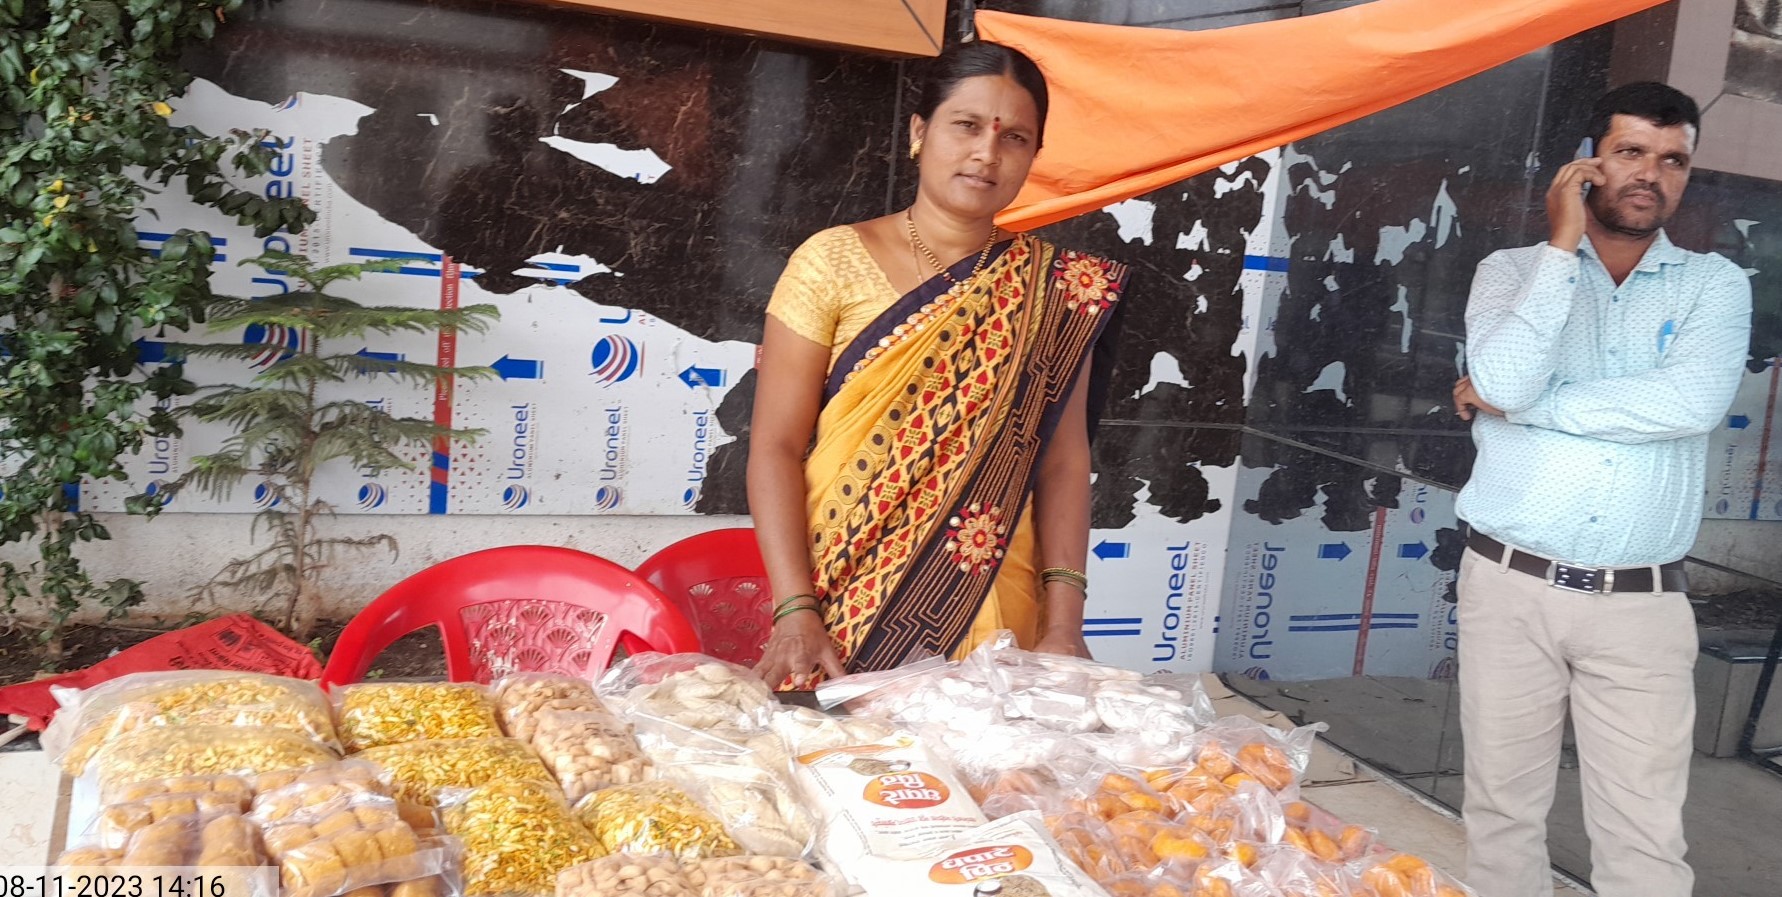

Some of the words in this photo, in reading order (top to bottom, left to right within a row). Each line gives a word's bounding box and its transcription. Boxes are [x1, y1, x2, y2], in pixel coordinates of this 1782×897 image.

[250, 136, 294, 301] Uroeel
[507, 403, 529, 480] Uroneel
[599, 406, 622, 481] Uroneel
[687, 409, 709, 482] Uroneel
[1187, 574, 1197, 603] PANEL
[1191, 541, 1201, 570] SHEET
[1152, 541, 1190, 662] Uroneel
[1180, 605, 1193, 660] ALUMINIUM
